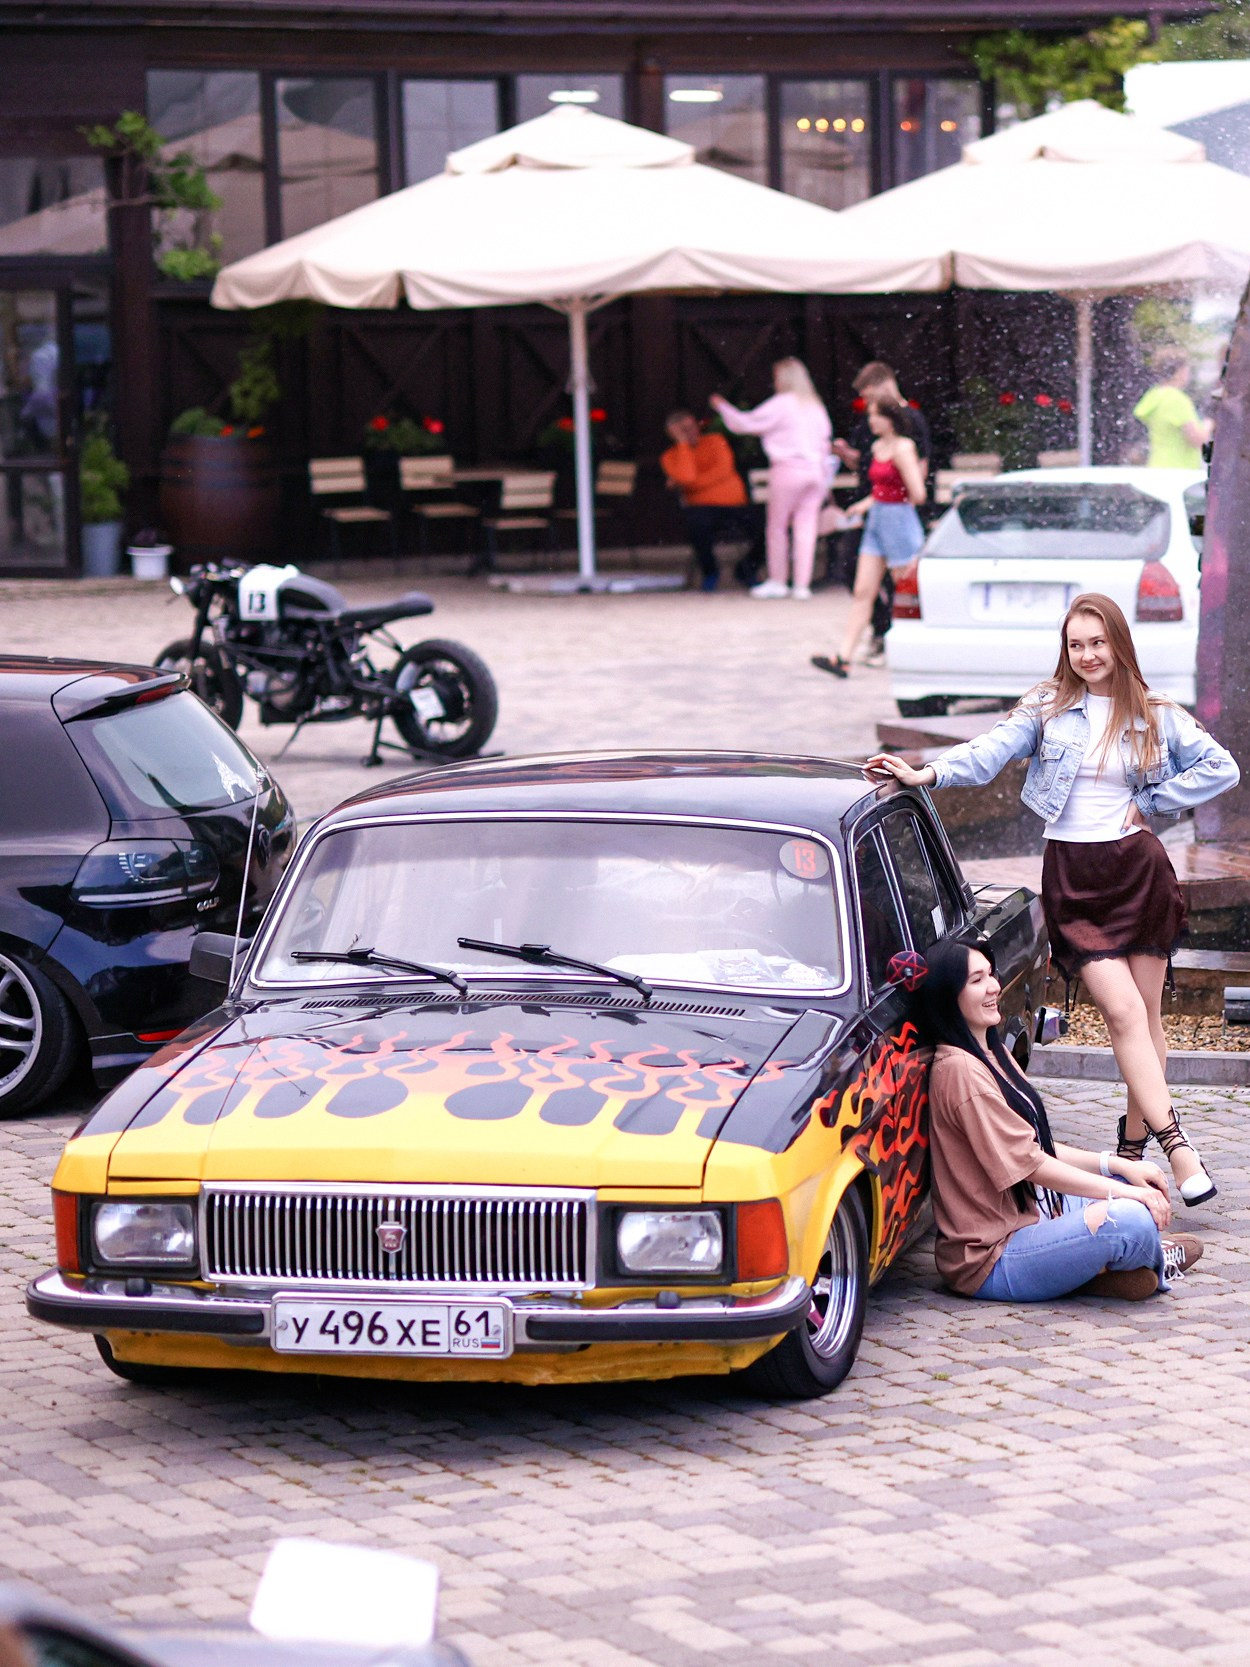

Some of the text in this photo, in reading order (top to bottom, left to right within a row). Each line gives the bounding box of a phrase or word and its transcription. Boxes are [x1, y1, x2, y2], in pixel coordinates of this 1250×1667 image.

[248, 592, 266, 613] 13
[794, 847, 817, 873] 13
[454, 1309, 491, 1337] 61
[452, 1337, 480, 1349] RUS
